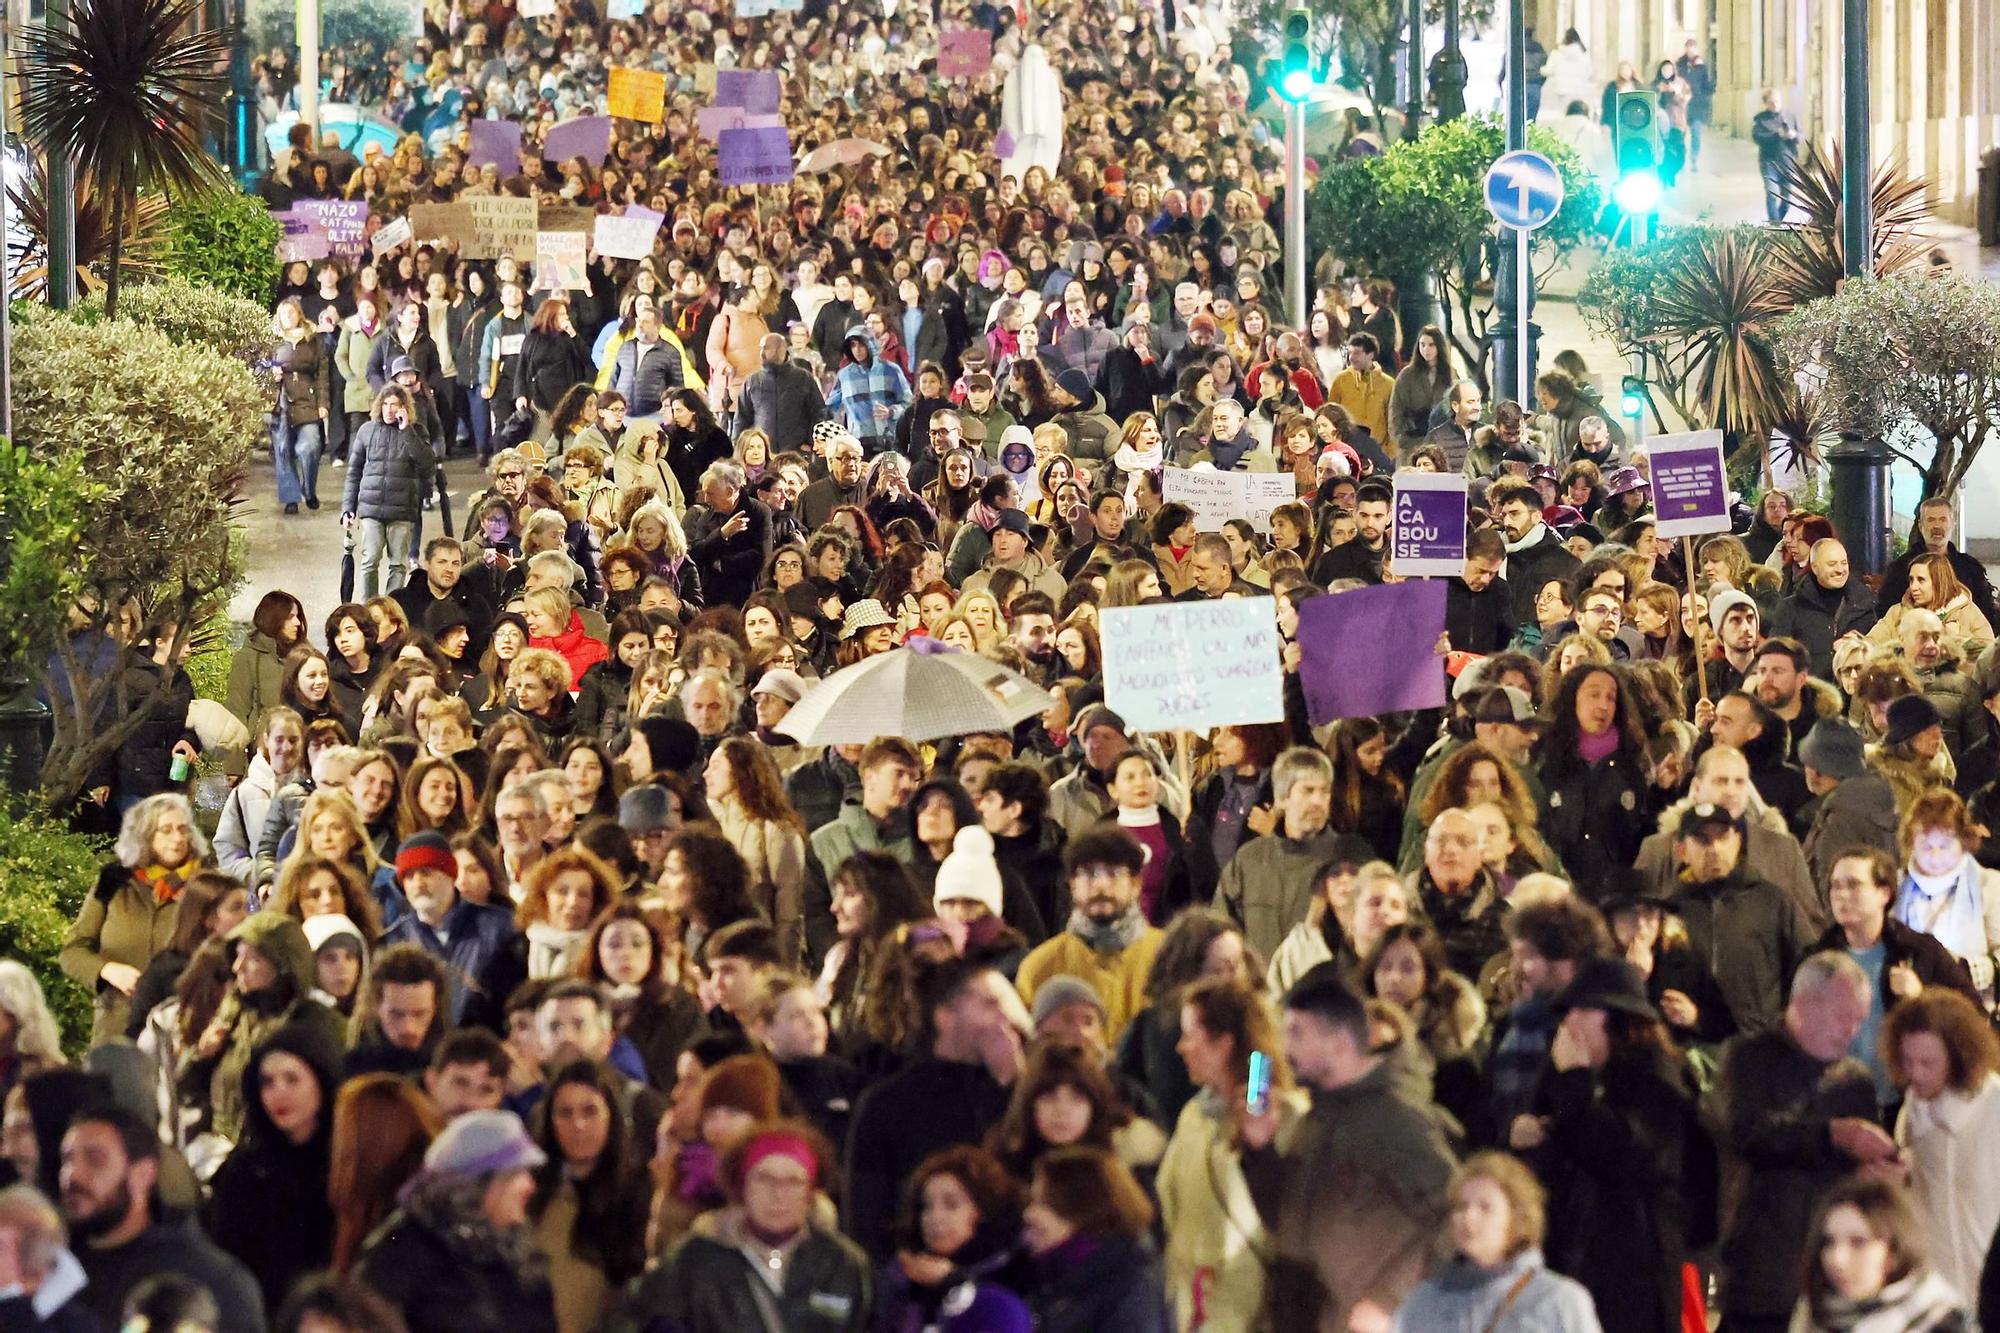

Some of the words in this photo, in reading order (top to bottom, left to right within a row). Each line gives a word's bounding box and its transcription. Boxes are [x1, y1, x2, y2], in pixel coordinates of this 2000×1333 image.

[1399, 493, 1412, 507] A
[1399, 510, 1425, 524] CA
[1399, 527, 1438, 541] BOU
[1398, 544, 1421, 558] SE
